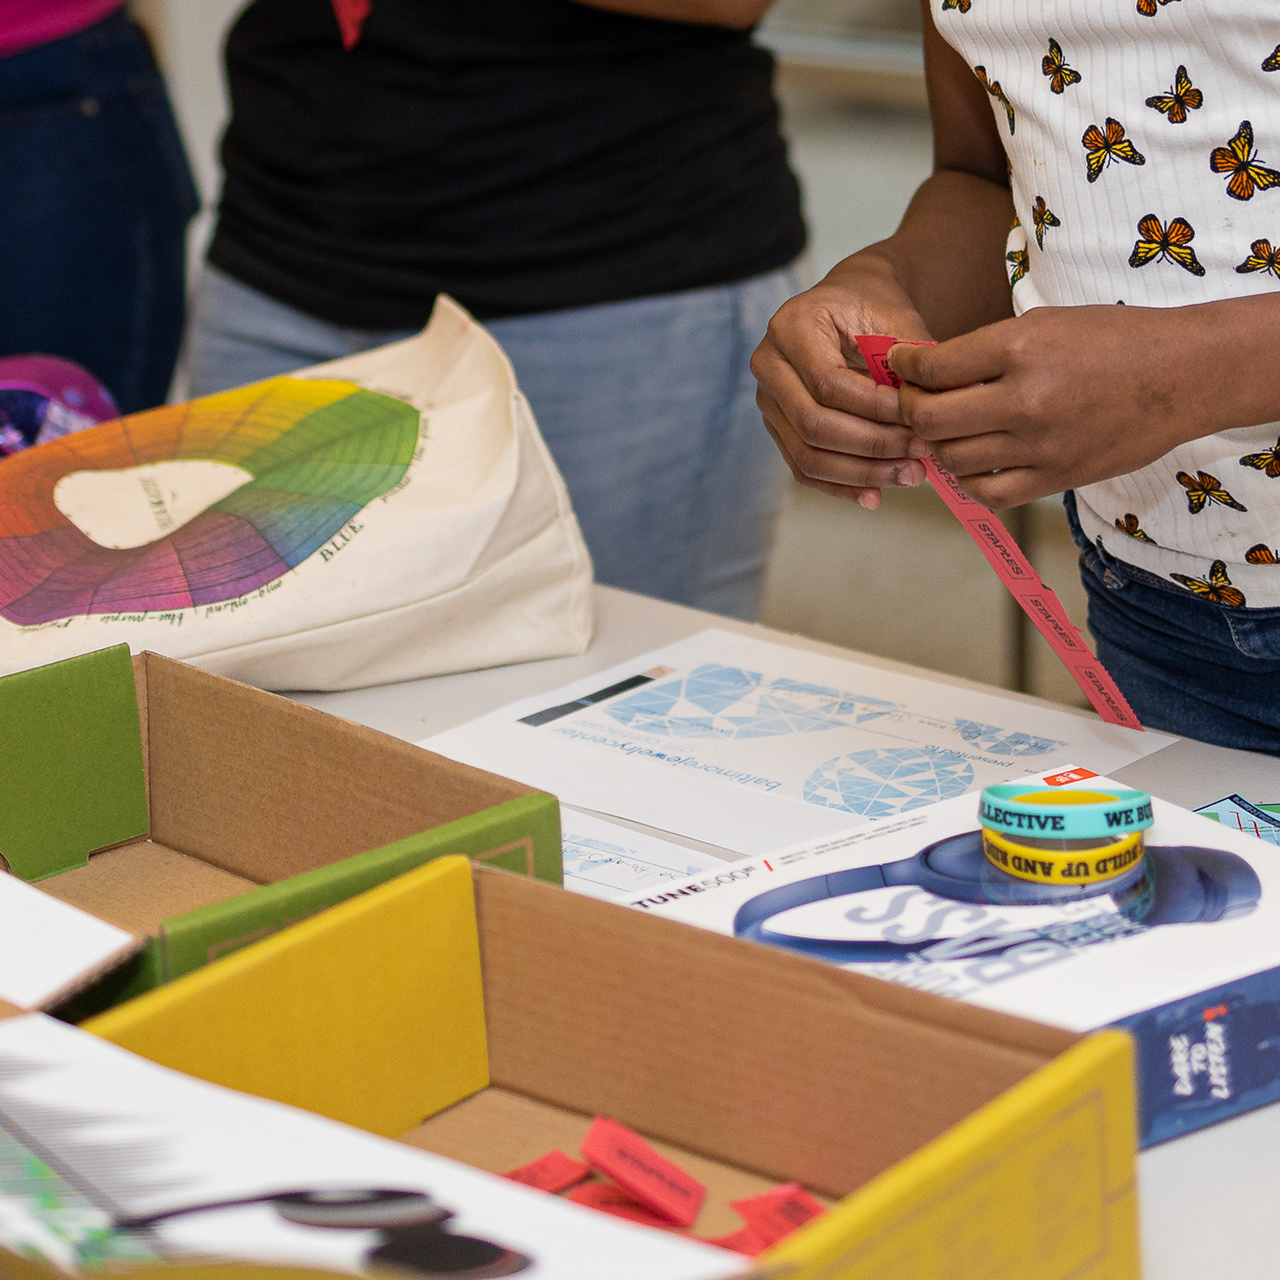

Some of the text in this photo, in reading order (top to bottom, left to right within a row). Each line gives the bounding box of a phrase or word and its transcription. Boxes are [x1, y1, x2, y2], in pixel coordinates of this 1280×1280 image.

[929, 453, 972, 503] TAPLES
[318, 519, 365, 565] BLUE
[977, 522, 1025, 579] STAPLES
[1028, 598, 1077, 650] STAPLES
[1083, 668, 1129, 724] STAPLES
[551, 725, 783, 793] baltimorejewelrycenter
[923, 743, 1015, 770] presented to
[1105, 809, 1134, 828] WE
[1011, 855, 1055, 878] AND
[1061, 861, 1090, 878] UP
[1096, 847, 1139, 875] BUILD
